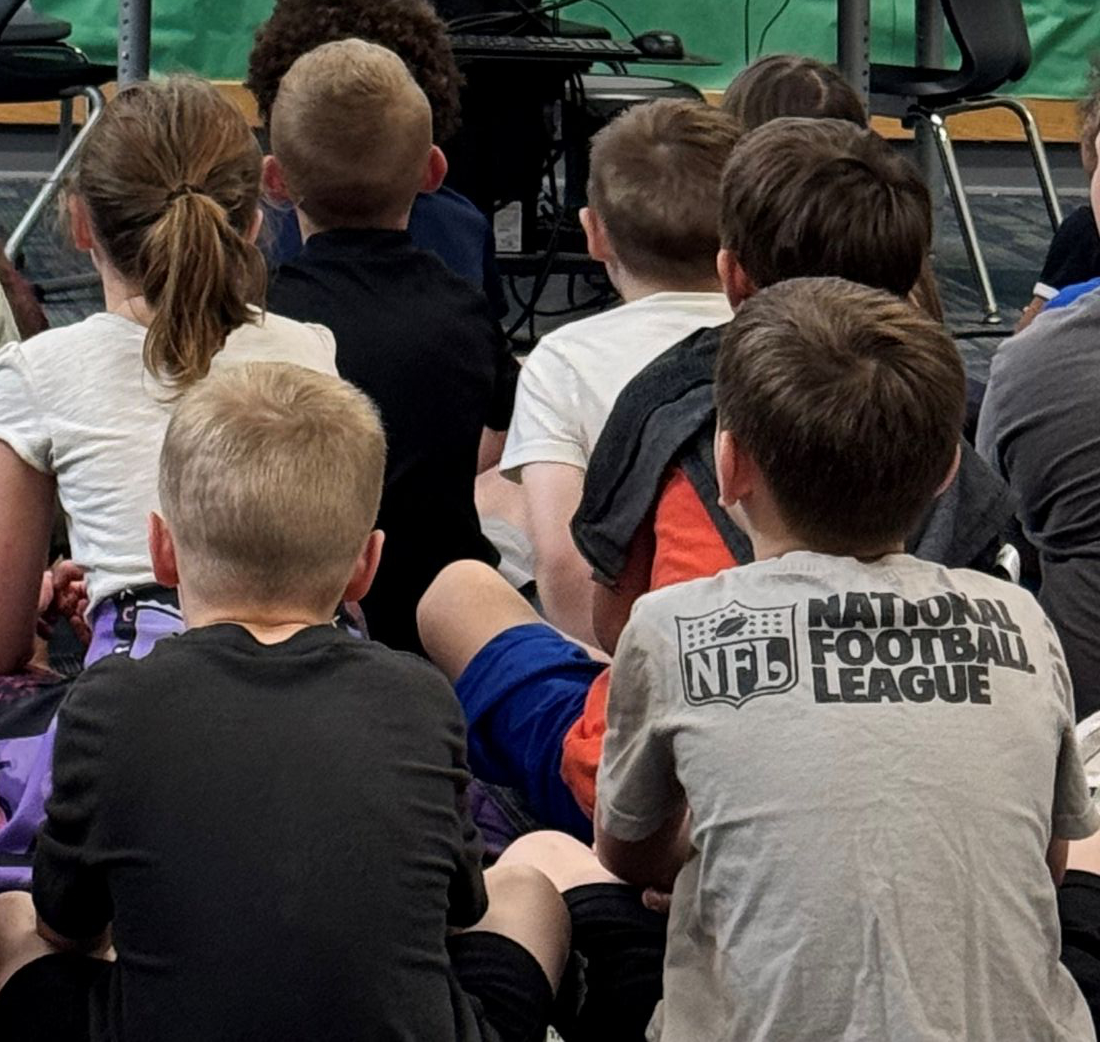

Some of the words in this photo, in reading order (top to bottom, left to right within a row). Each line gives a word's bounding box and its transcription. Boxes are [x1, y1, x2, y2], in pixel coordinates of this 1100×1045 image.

[808, 591, 1021, 634] NATIONAL
[688, 639, 789, 699] NFL
[808, 628, 1037, 674] FOOTBALL
[812, 664, 992, 705] LEAGUE
